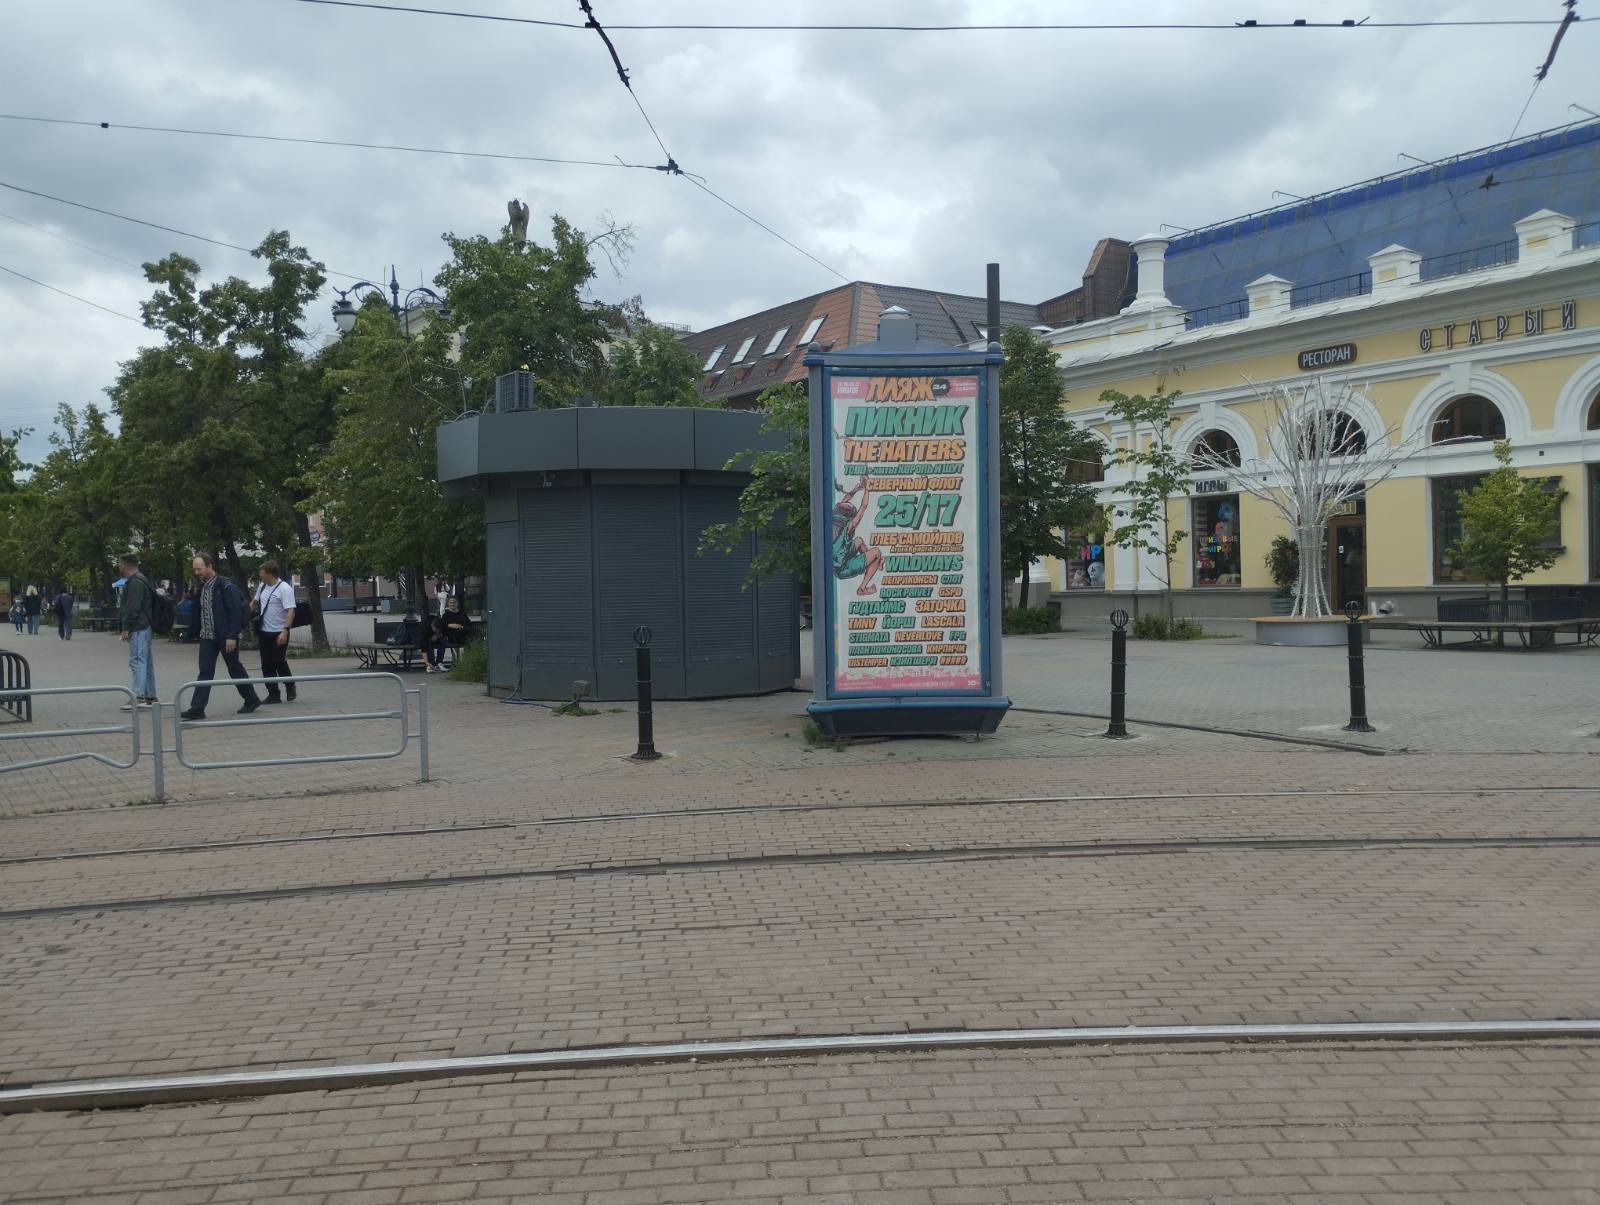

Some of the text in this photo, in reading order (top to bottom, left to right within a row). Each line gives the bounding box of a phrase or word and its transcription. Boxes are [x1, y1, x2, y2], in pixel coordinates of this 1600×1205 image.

[1419, 299, 1577, 352] СТАРЫЙ
[1302, 346, 1351, 369] РЕСТОРАН
[845, 405, 969, 437] ПИКНИК
[844, 439, 966, 462] THE HATTERS
[898, 464, 934, 475] КОРОЛЬ
[940, 463, 964, 474] ШУТ
[865, 476, 964, 491] СЕВЕРНЫЙ ФЛОТ
[874, 492, 962, 530] 25/17
[870, 530, 964, 546] ГЛЕБ САМОЙЛОВ
[885, 555, 964, 573] WILDWAYS
[881, 574, 964, 585] ЛЕПРИКОНСЫ СЛОТ
[879, 586, 963, 598] ROCK PRIVET GSPD
[848, 598, 966, 616] ГУДТАЙМС ЗАТОЧКА
[848, 615, 965, 630] TMNV ЙОРШ LASCALA
[849, 632, 890, 643] STIGMATA
[895, 630, 945, 642] NEVERLOVE
[926, 644, 967, 654] КИРПИЧИ
[848, 658, 889, 668] DISTEMPER
